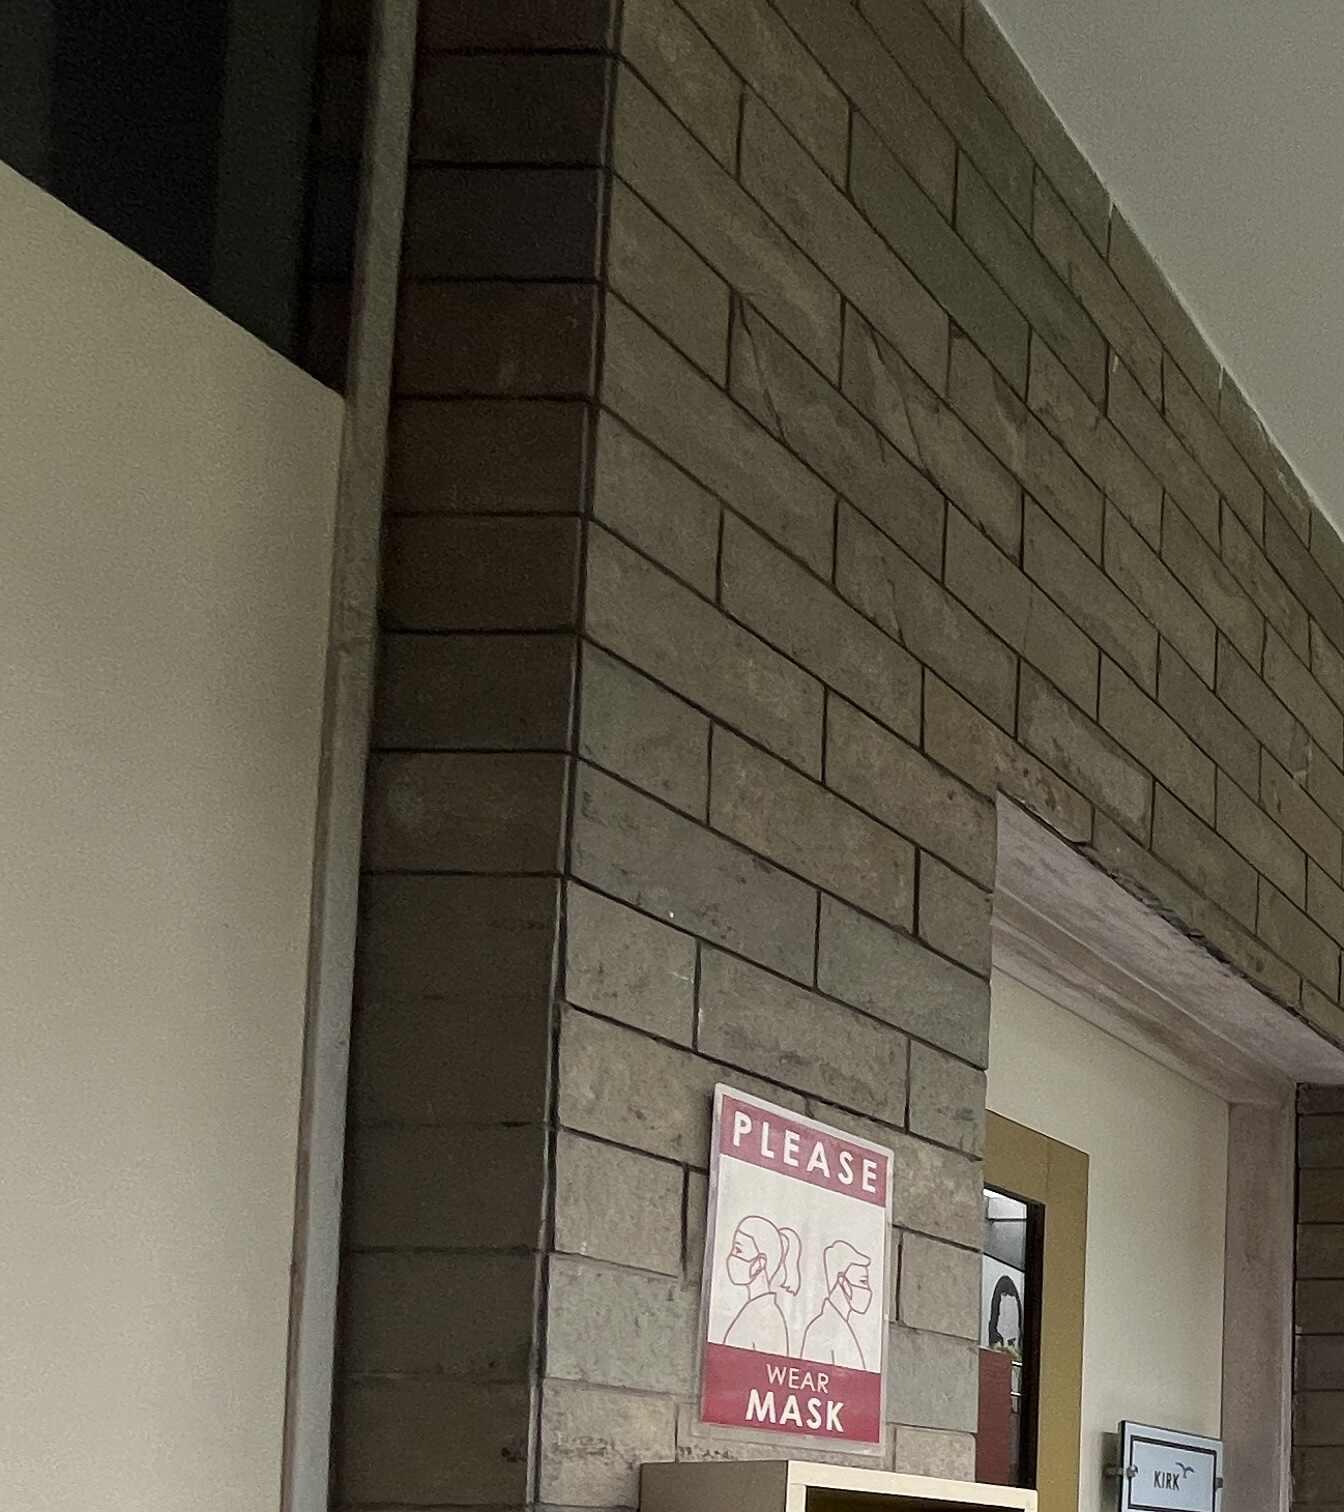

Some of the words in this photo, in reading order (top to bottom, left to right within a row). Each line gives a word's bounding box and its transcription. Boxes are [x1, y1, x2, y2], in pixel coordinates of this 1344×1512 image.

[732, 1110, 878, 1193] PLEASE
[766, 1363, 829, 1394] WEAR
[744, 1388, 845, 1433] MASK
[1152, 1470, 1181, 1492] KIRK
